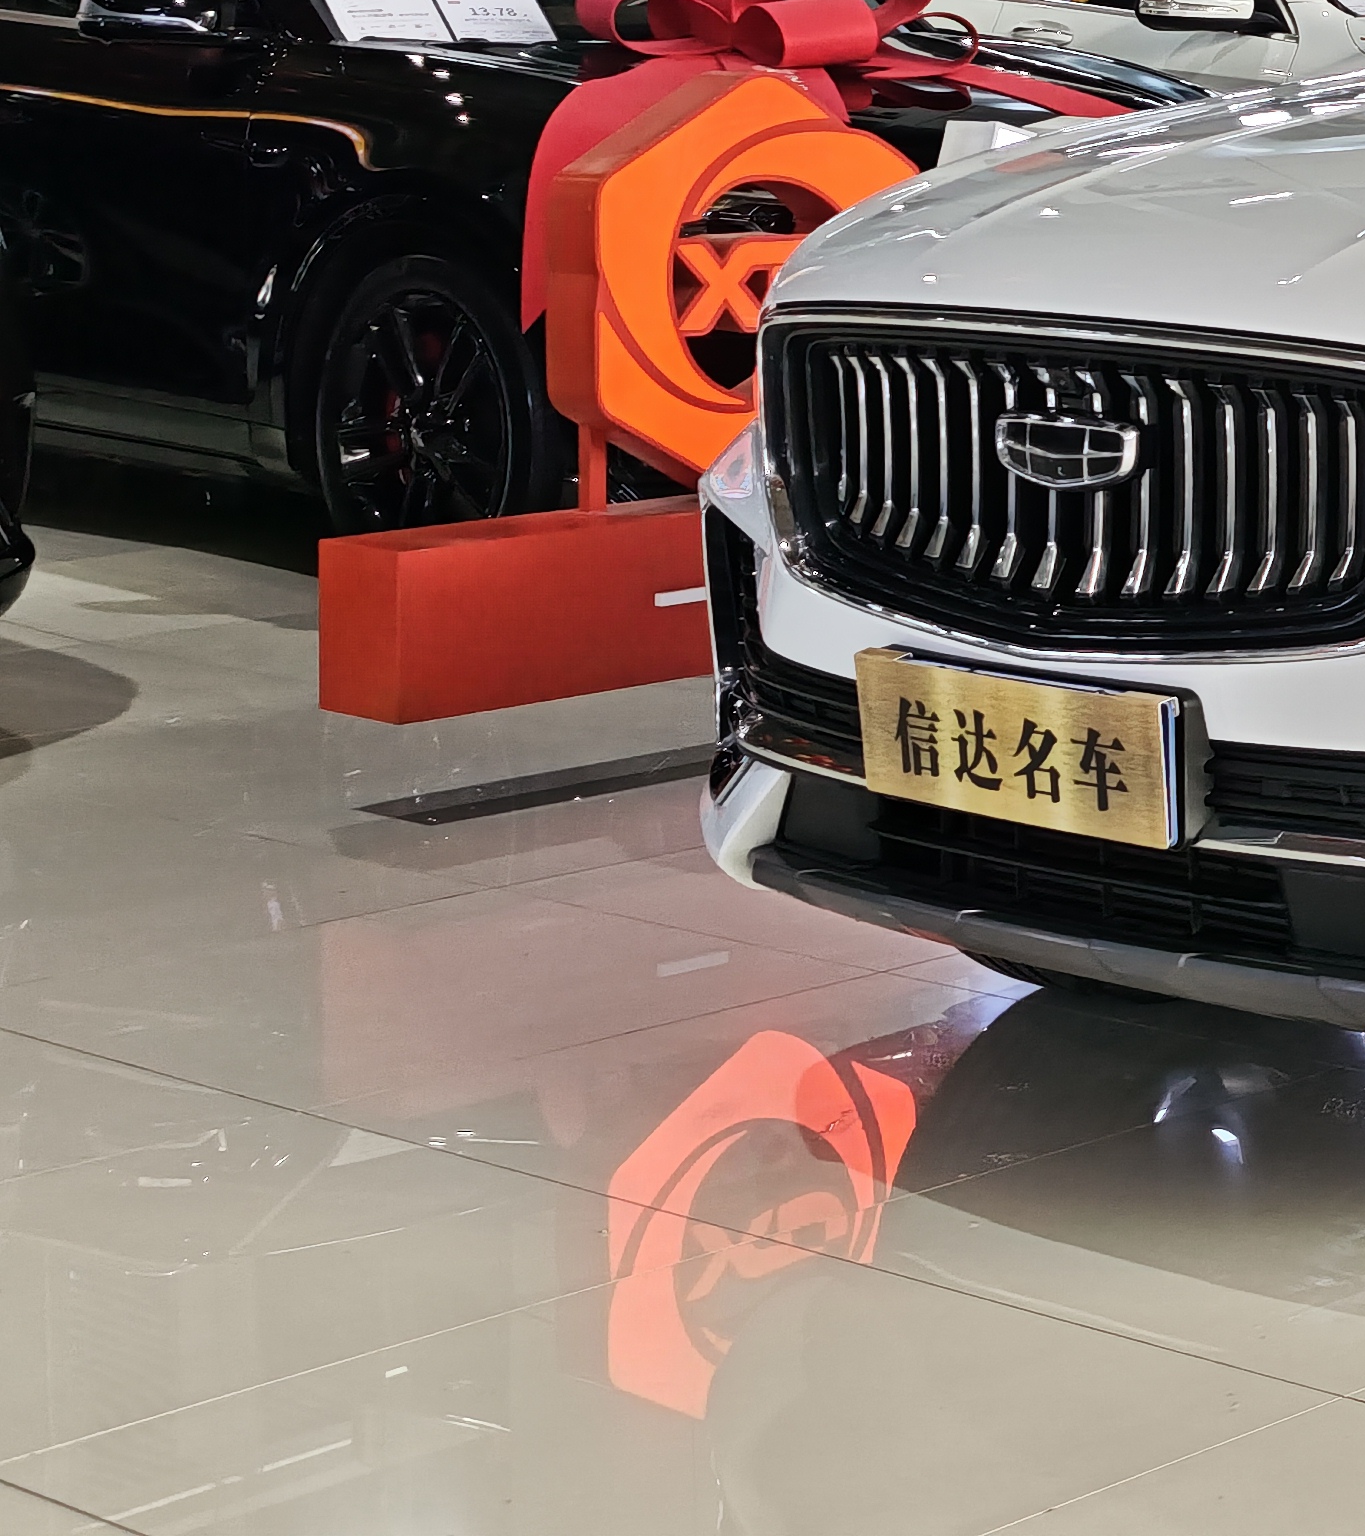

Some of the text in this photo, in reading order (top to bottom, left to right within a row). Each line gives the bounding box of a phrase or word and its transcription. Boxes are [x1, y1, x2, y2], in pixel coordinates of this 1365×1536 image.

[468, 6, 518, 17] 13.78
[894, 695, 1129, 812] 信达名车
